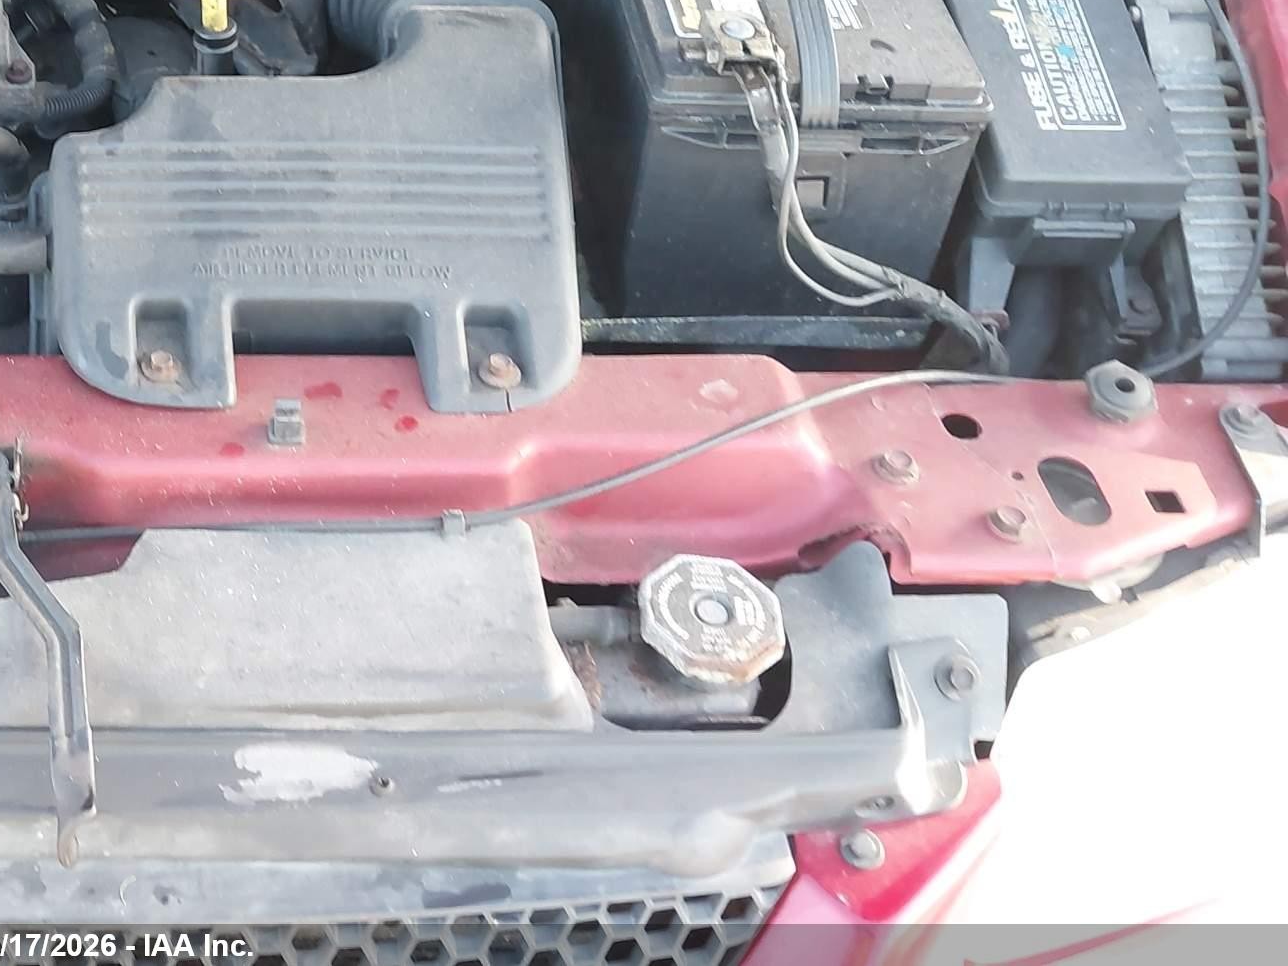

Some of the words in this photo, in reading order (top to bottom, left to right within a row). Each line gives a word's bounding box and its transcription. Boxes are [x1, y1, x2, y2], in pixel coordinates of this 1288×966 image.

[1017, 51, 1037, 68] &
[1022, 71, 1058, 130] FUSE
[310, 245, 332, 260] TO
[336, 246, 409, 262] SERVICE
